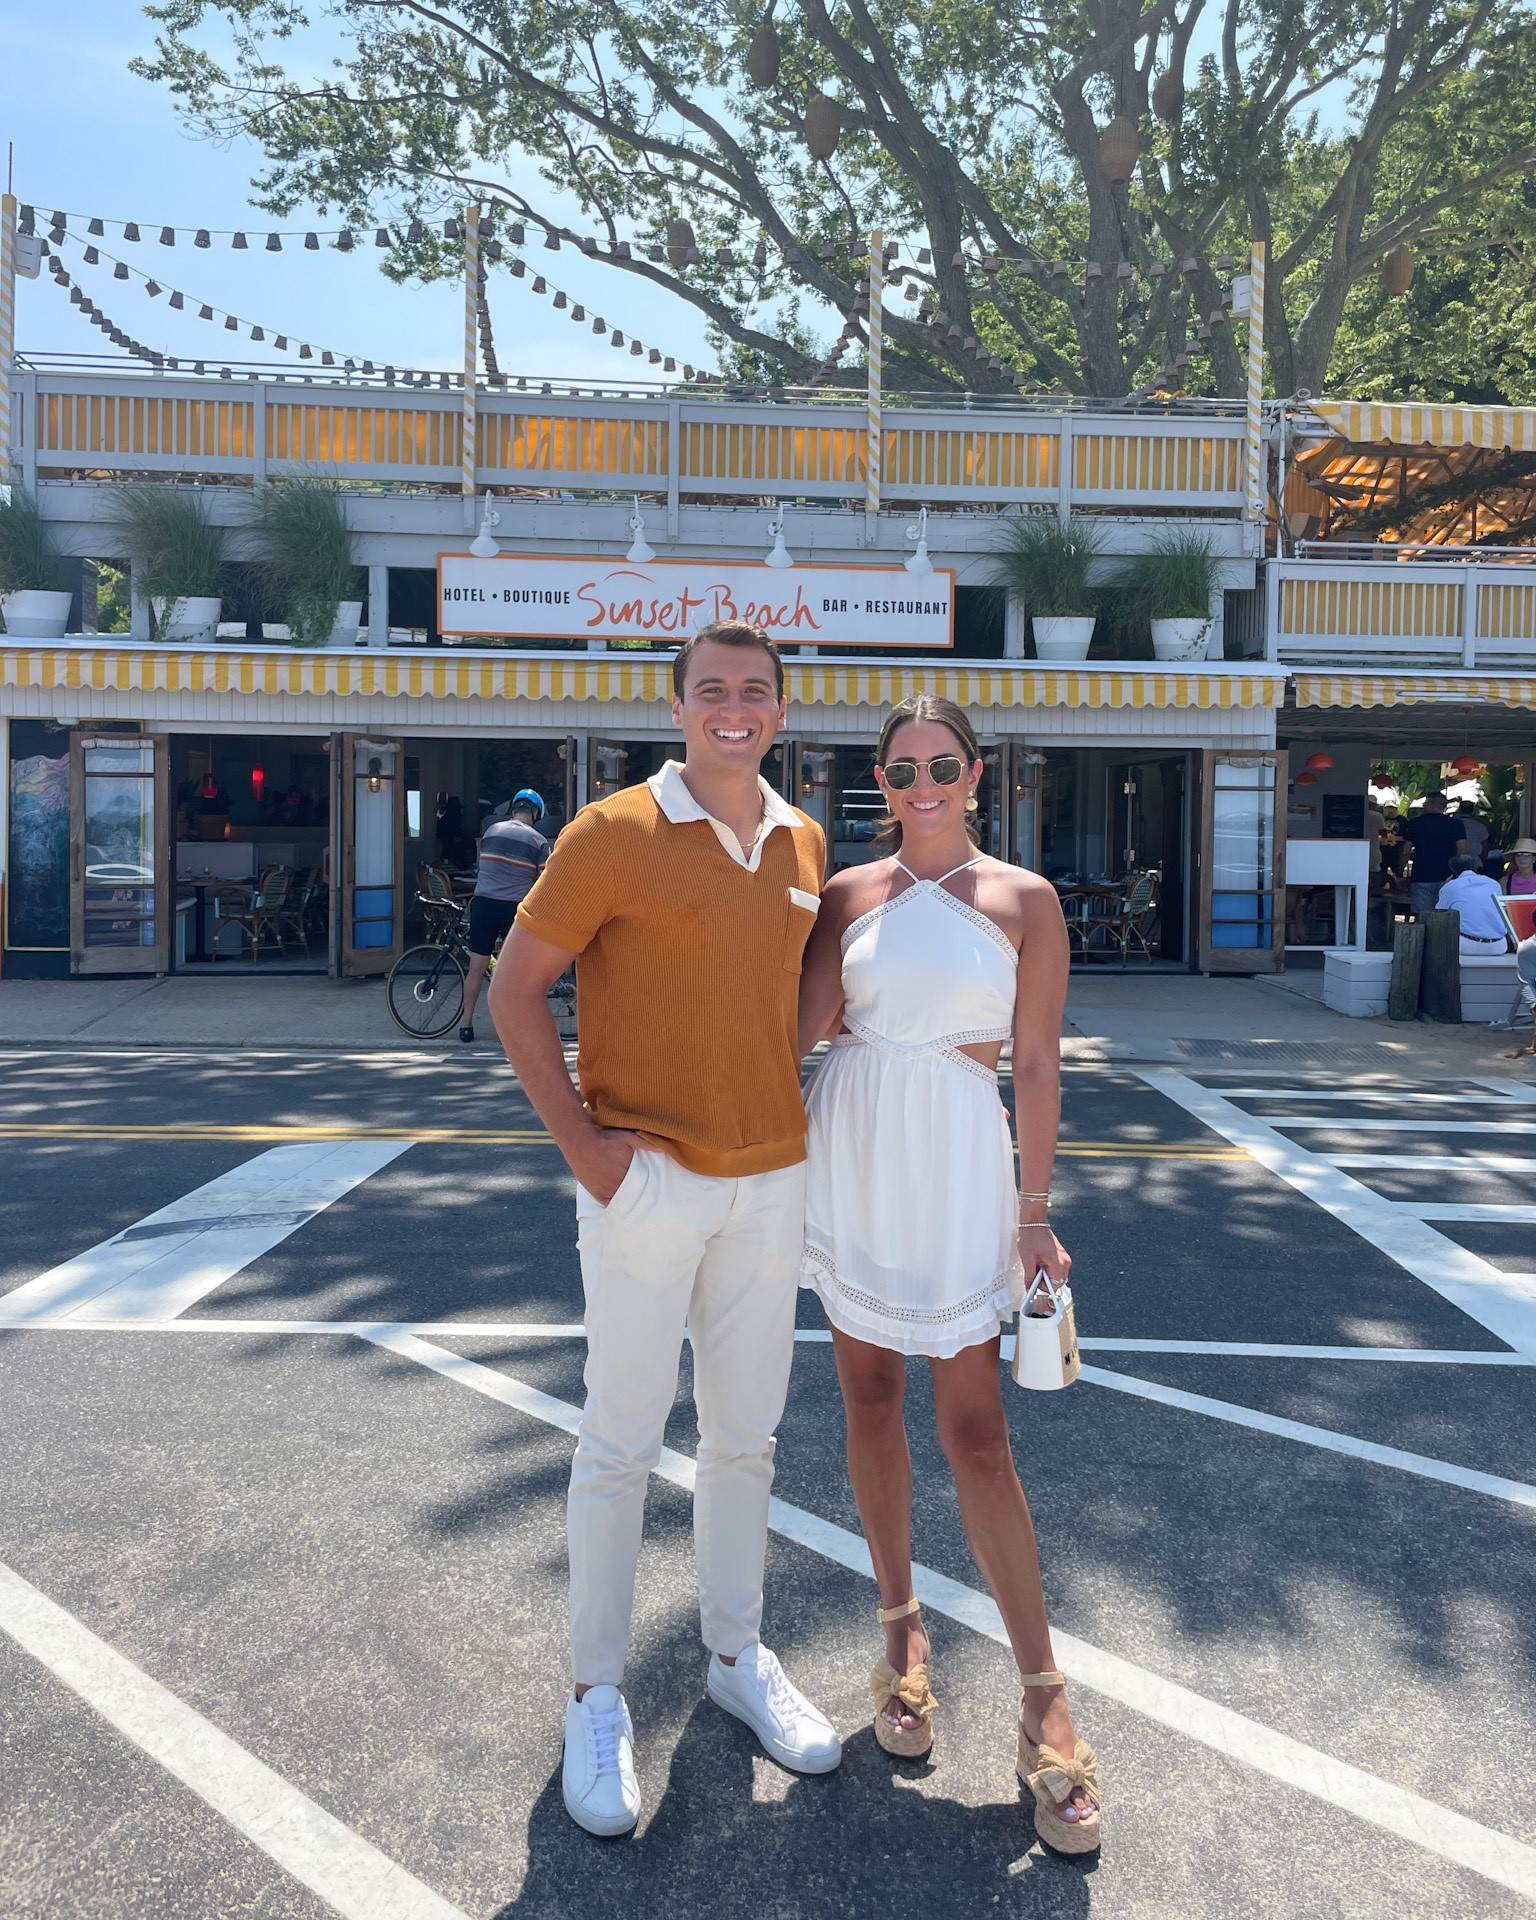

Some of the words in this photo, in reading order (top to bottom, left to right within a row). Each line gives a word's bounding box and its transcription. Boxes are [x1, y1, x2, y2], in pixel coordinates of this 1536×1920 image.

[443, 587, 486, 602] HOTEL
[503, 589, 571, 605] BOUTIQUE
[577, 582, 706, 632] Sunset
[705, 584, 822, 630] Beach
[822, 599, 848, 613] BAR
[865, 600, 948, 615] RESTAURANT
